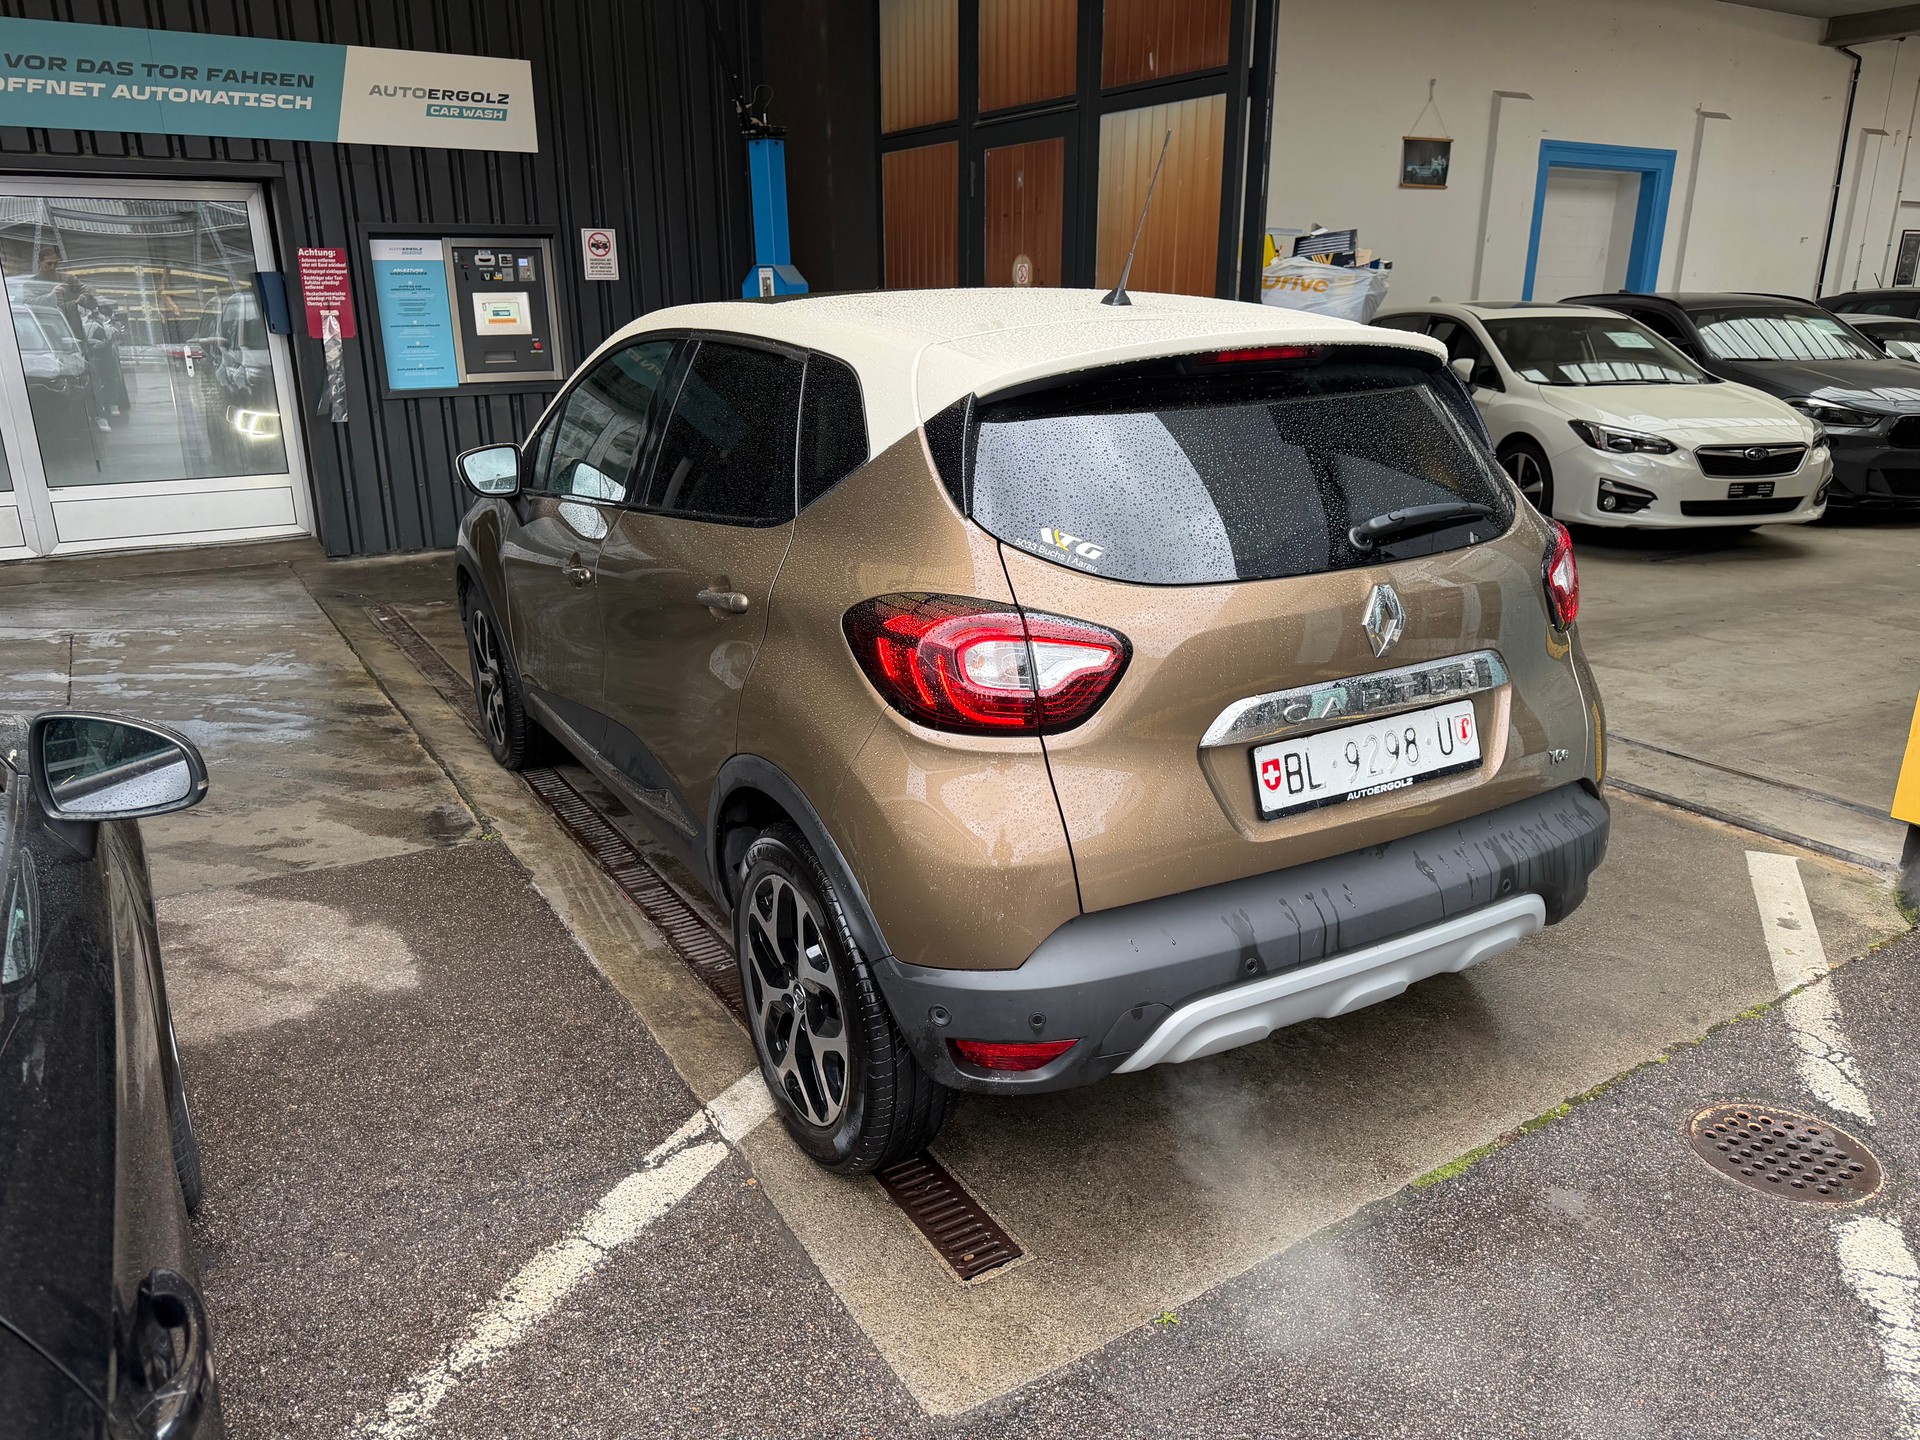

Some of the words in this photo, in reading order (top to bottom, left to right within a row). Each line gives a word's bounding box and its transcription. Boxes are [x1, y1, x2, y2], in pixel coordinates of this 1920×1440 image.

[4, 53, 67, 72] VOR
[76, 58, 134, 76] DAS
[141, 63, 198, 81] TOR
[206, 67, 315, 88] FAHREN
[111, 84, 313, 110] AUTOMATISCH
[368, 84, 510, 105] AUTOERGOLZ
[430, 106, 460, 116] CAR
[462, 108, 503, 119] WASH
[298, 248, 336, 258] Achtung:
[1015, 537, 1037, 551] 5033
[1038, 545, 1066, 560] Buchs
[1071, 558, 1098, 573] Aarau
[1283, 668, 1477, 725] CAPTUR
[1284, 749, 1326, 795] BL
[1344, 727, 1420, 784] 9298
[1436, 716, 1453, 757] U
[1346, 777, 1414, 801] AUTOERGOLZ
